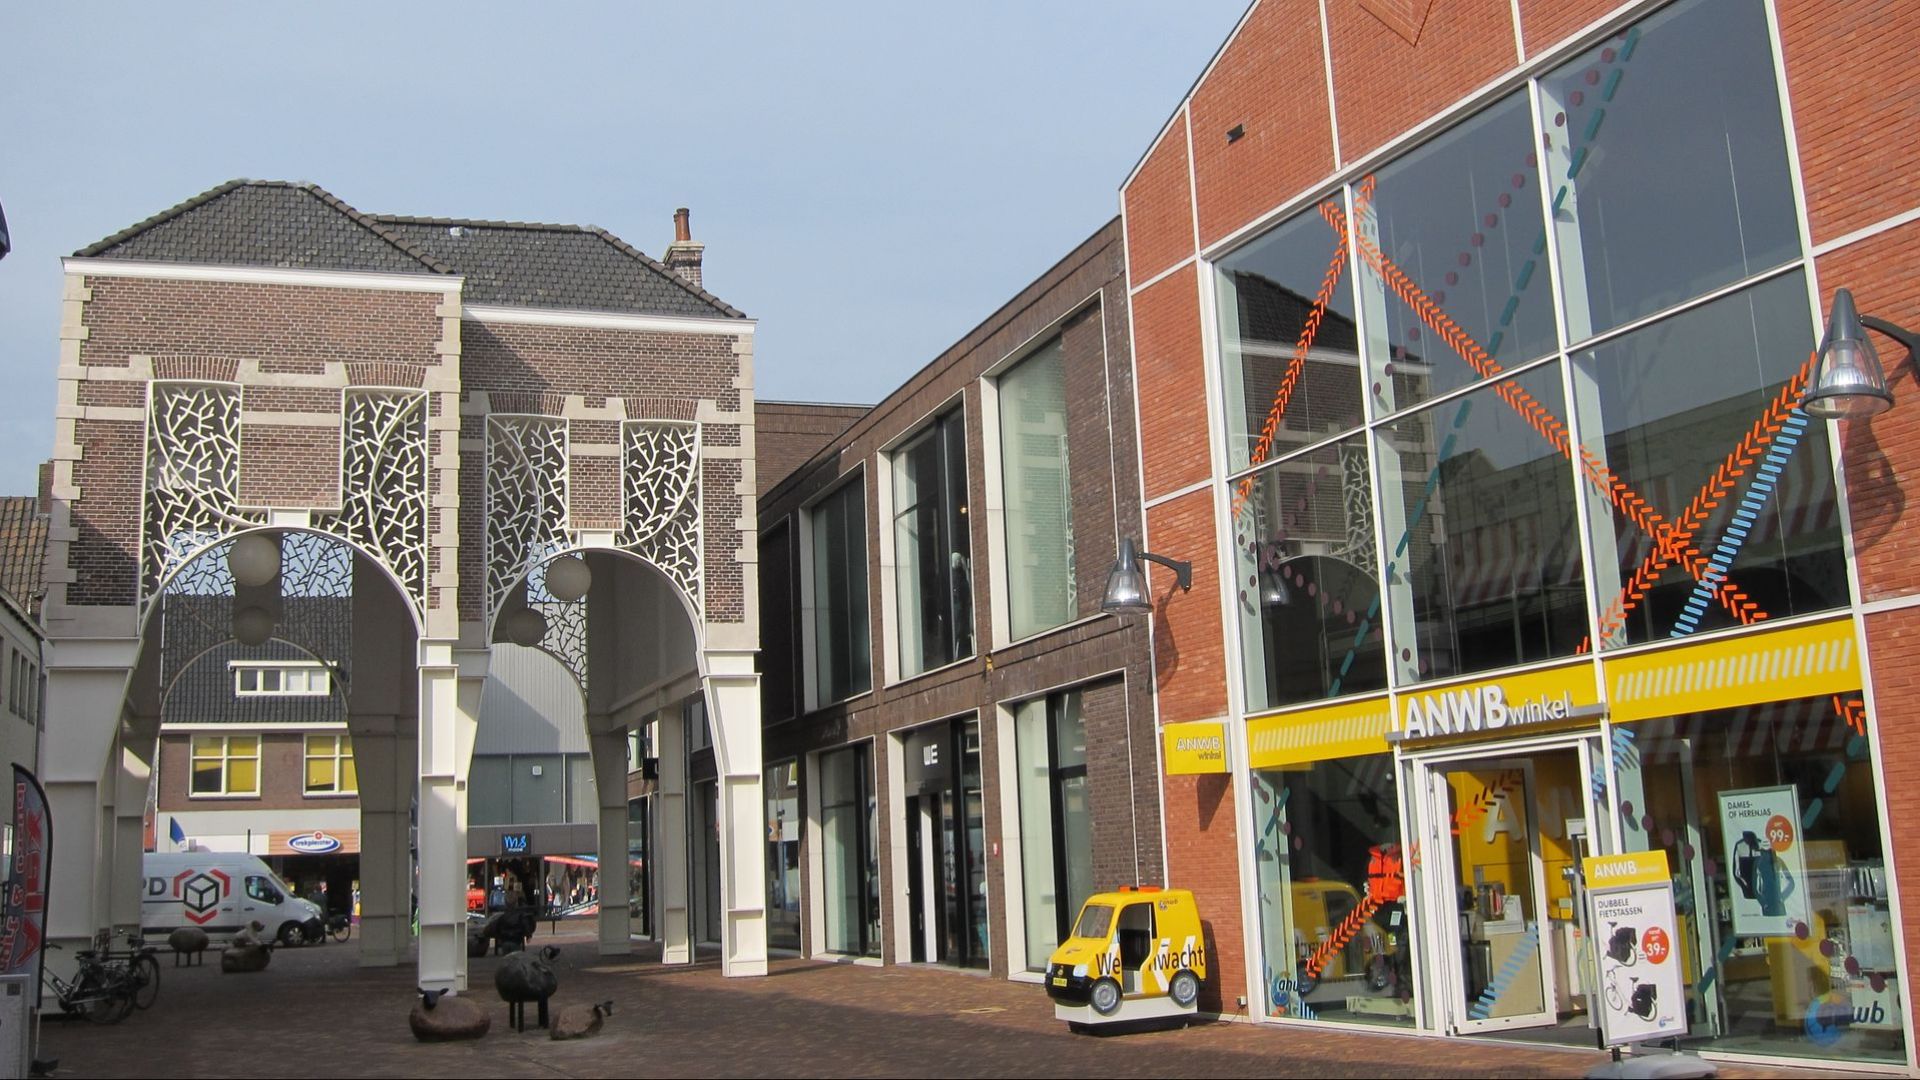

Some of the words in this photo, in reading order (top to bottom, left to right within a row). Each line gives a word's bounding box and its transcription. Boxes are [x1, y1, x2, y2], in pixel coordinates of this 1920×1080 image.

[1404, 685, 1508, 739] ANWB
[1508, 690, 1570, 725] winkel
[1176, 736, 1221, 751] ANWB
[923, 744, 938, 766] WE
[1198, 750, 1222, 760] winkel
[1727, 801, 1753, 810] DAMES-
[1728, 811, 1737, 819] OF
[1738, 807, 1772, 818] HERENJAS
[1595, 861, 1637, 879] ANWB
[1598, 898, 1630, 909] DUBBELE
[1599, 907, 1644, 918] FIETSTASSEN
[1096, 953, 1121, 976] We
